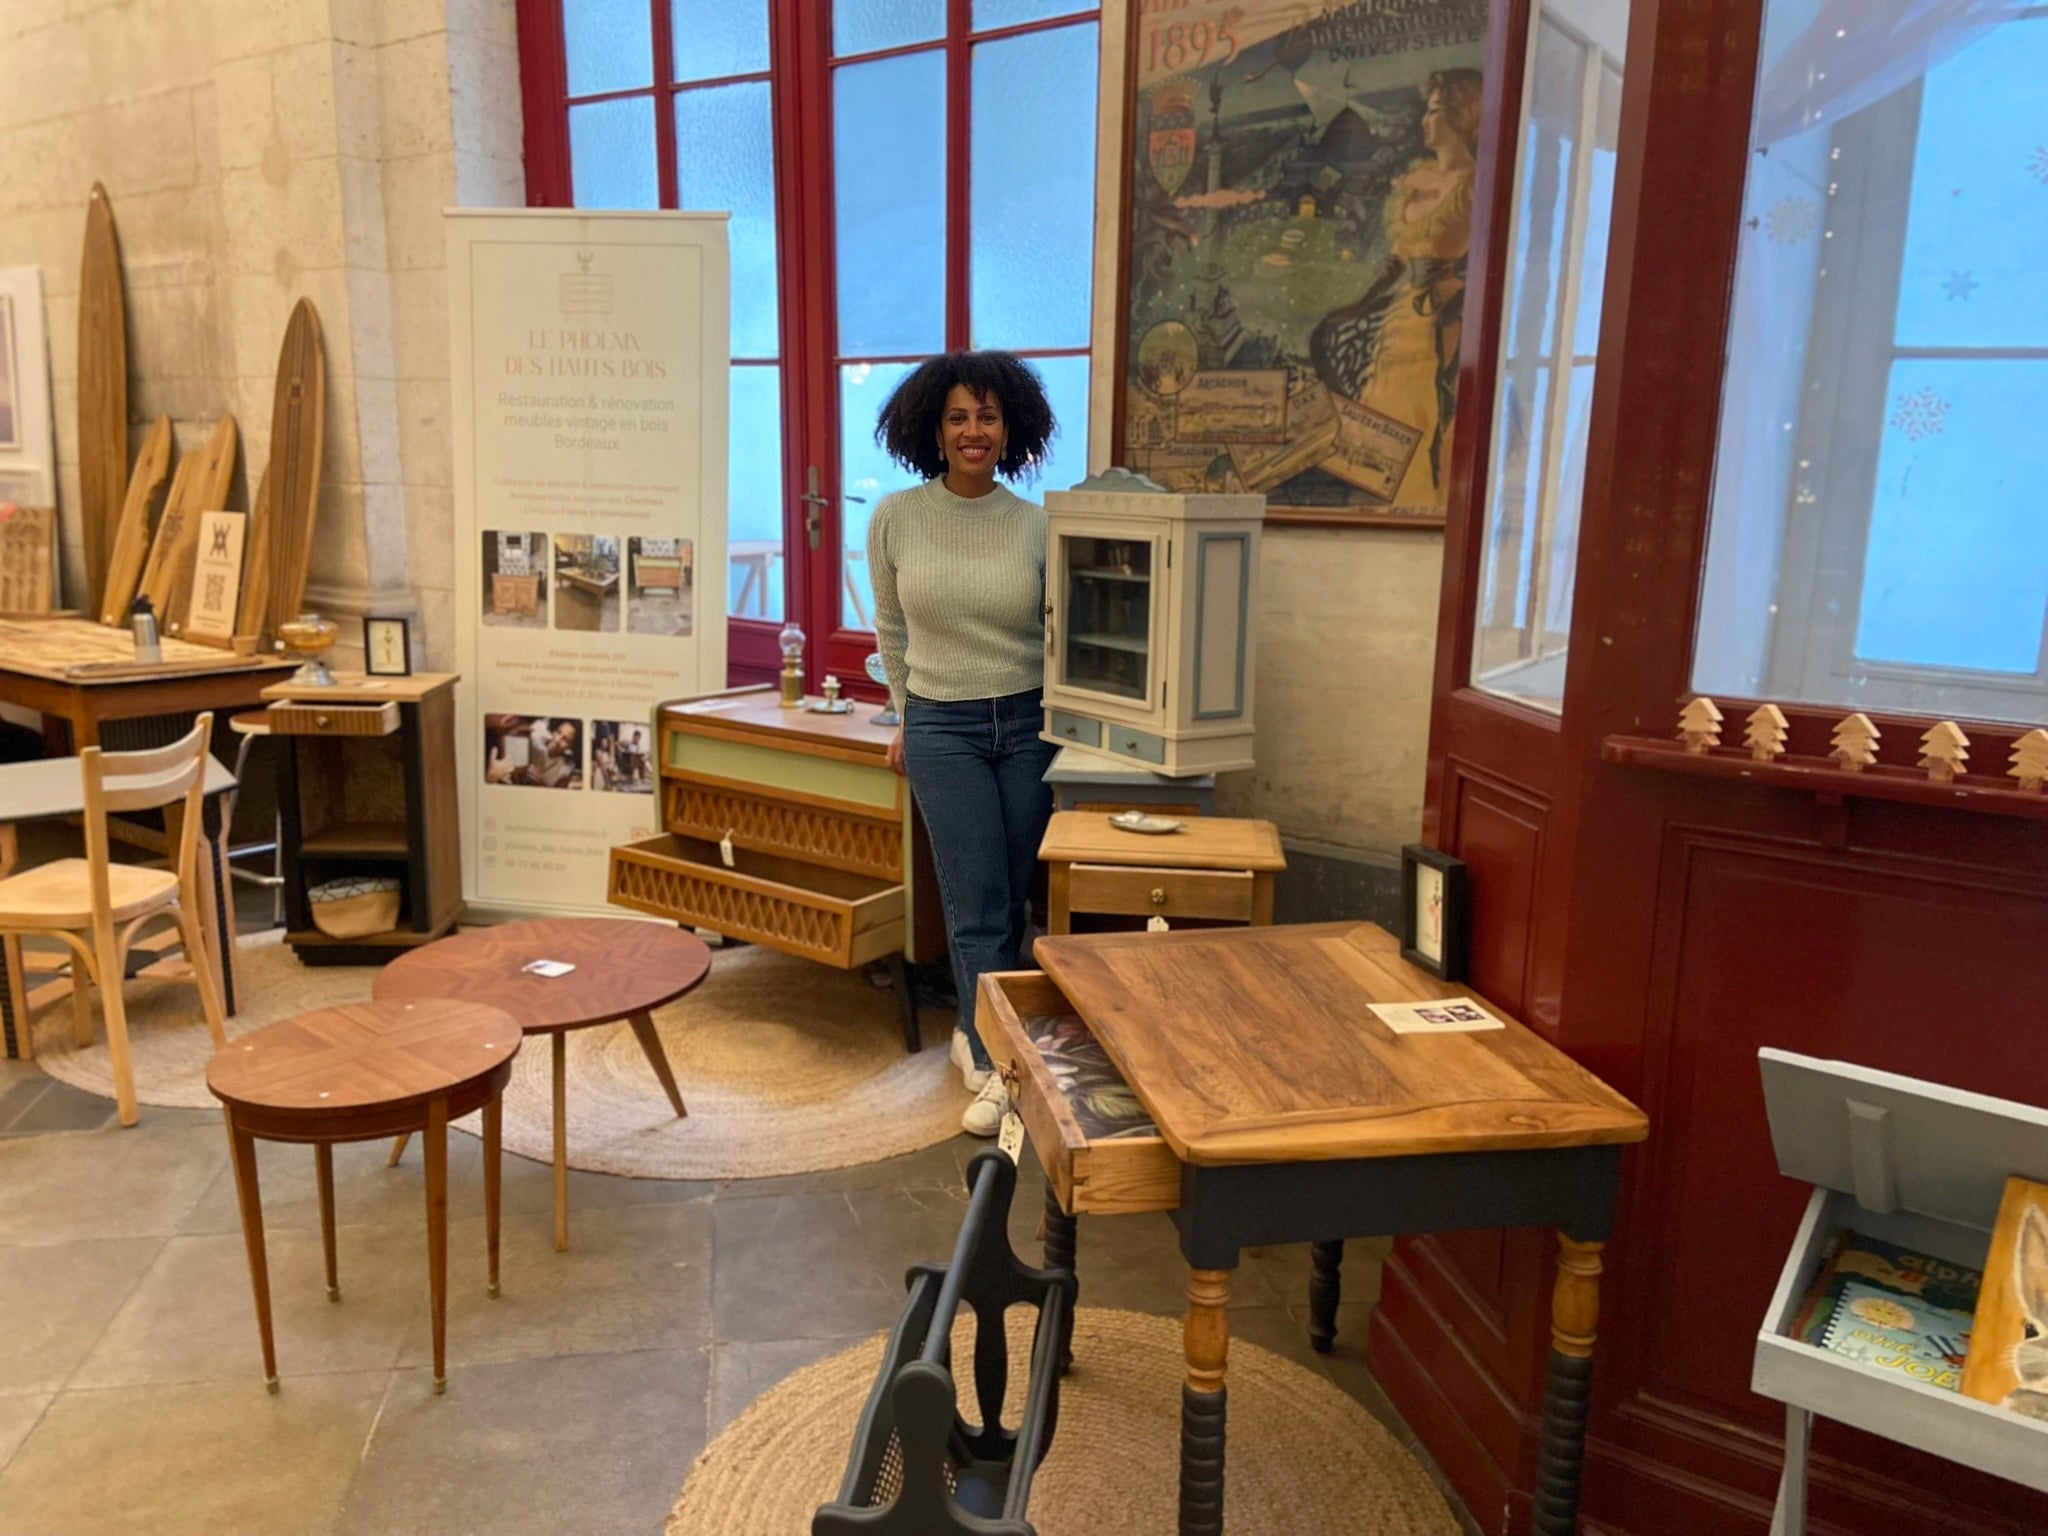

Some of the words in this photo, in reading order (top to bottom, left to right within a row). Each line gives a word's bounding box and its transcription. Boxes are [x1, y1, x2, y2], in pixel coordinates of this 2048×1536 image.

[1149, 6, 1245, 72] 1895
[1329, 27, 1480, 62] UNIVERSELLE
[528, 329, 554, 350] LE
[559, 330, 641, 351] PHOENIX
[504, 355, 543, 376] DES
[549, 356, 615, 377] HAUTS
[621, 359, 667, 379] BOIS
[498, 392, 585, 409] Restauration
[588, 395, 598, 409] &
[601, 396, 674, 411] rénovation
[503, 414, 563, 429] meubles
[565, 415, 617, 433] vintage
[619, 419, 637, 431] en
[640, 418, 669, 432] bois
[554, 434, 618, 450] Bordeaux
